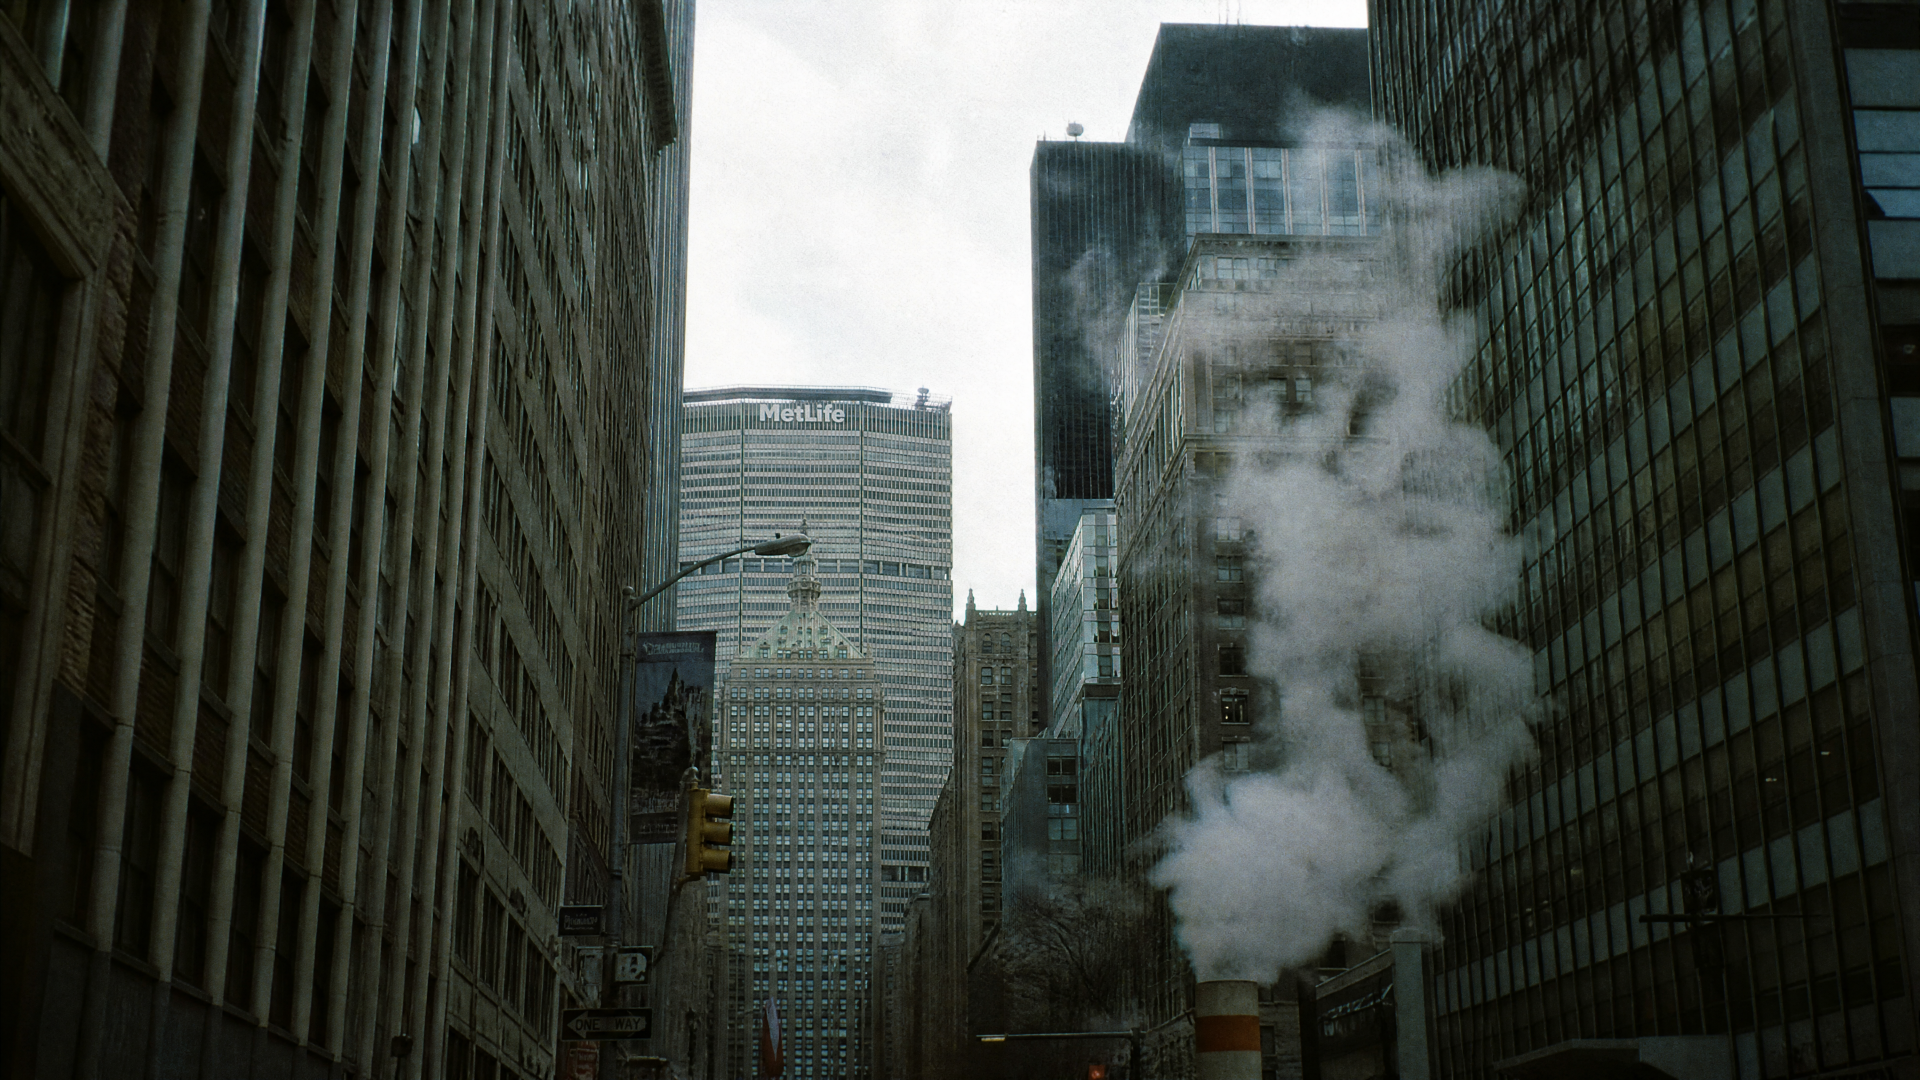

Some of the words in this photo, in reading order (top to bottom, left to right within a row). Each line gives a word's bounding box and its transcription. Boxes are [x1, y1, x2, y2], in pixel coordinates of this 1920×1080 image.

[760, 404, 845, 423] MetLife
[575, 1019, 600, 1031] ONE
[615, 1018, 640, 1030] WAY
